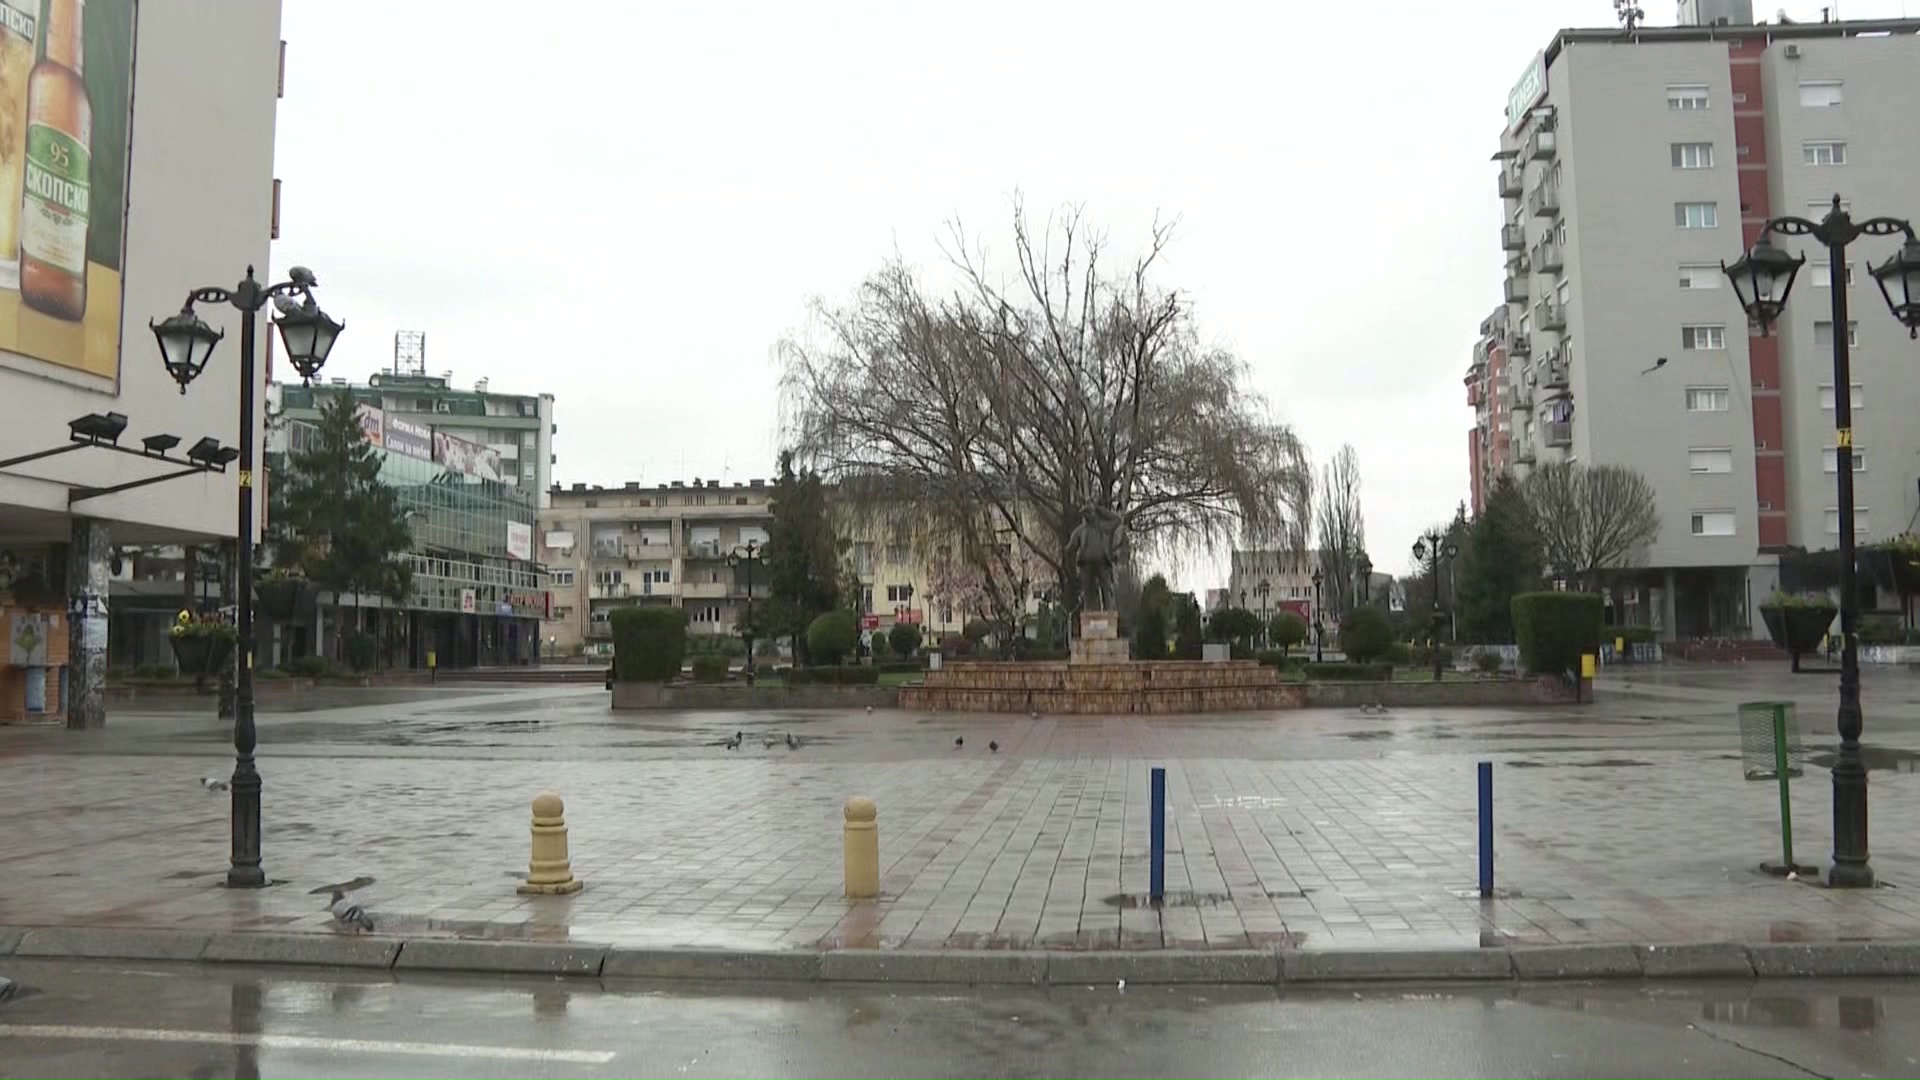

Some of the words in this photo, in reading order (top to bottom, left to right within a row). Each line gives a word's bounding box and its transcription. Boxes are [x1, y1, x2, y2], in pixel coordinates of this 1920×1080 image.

[1512, 63, 1540, 120] TINEX
[51, 141, 69, 166] 95
[26, 162, 89, 213] СКОПСКО
[364, 410, 379, 432] dm
